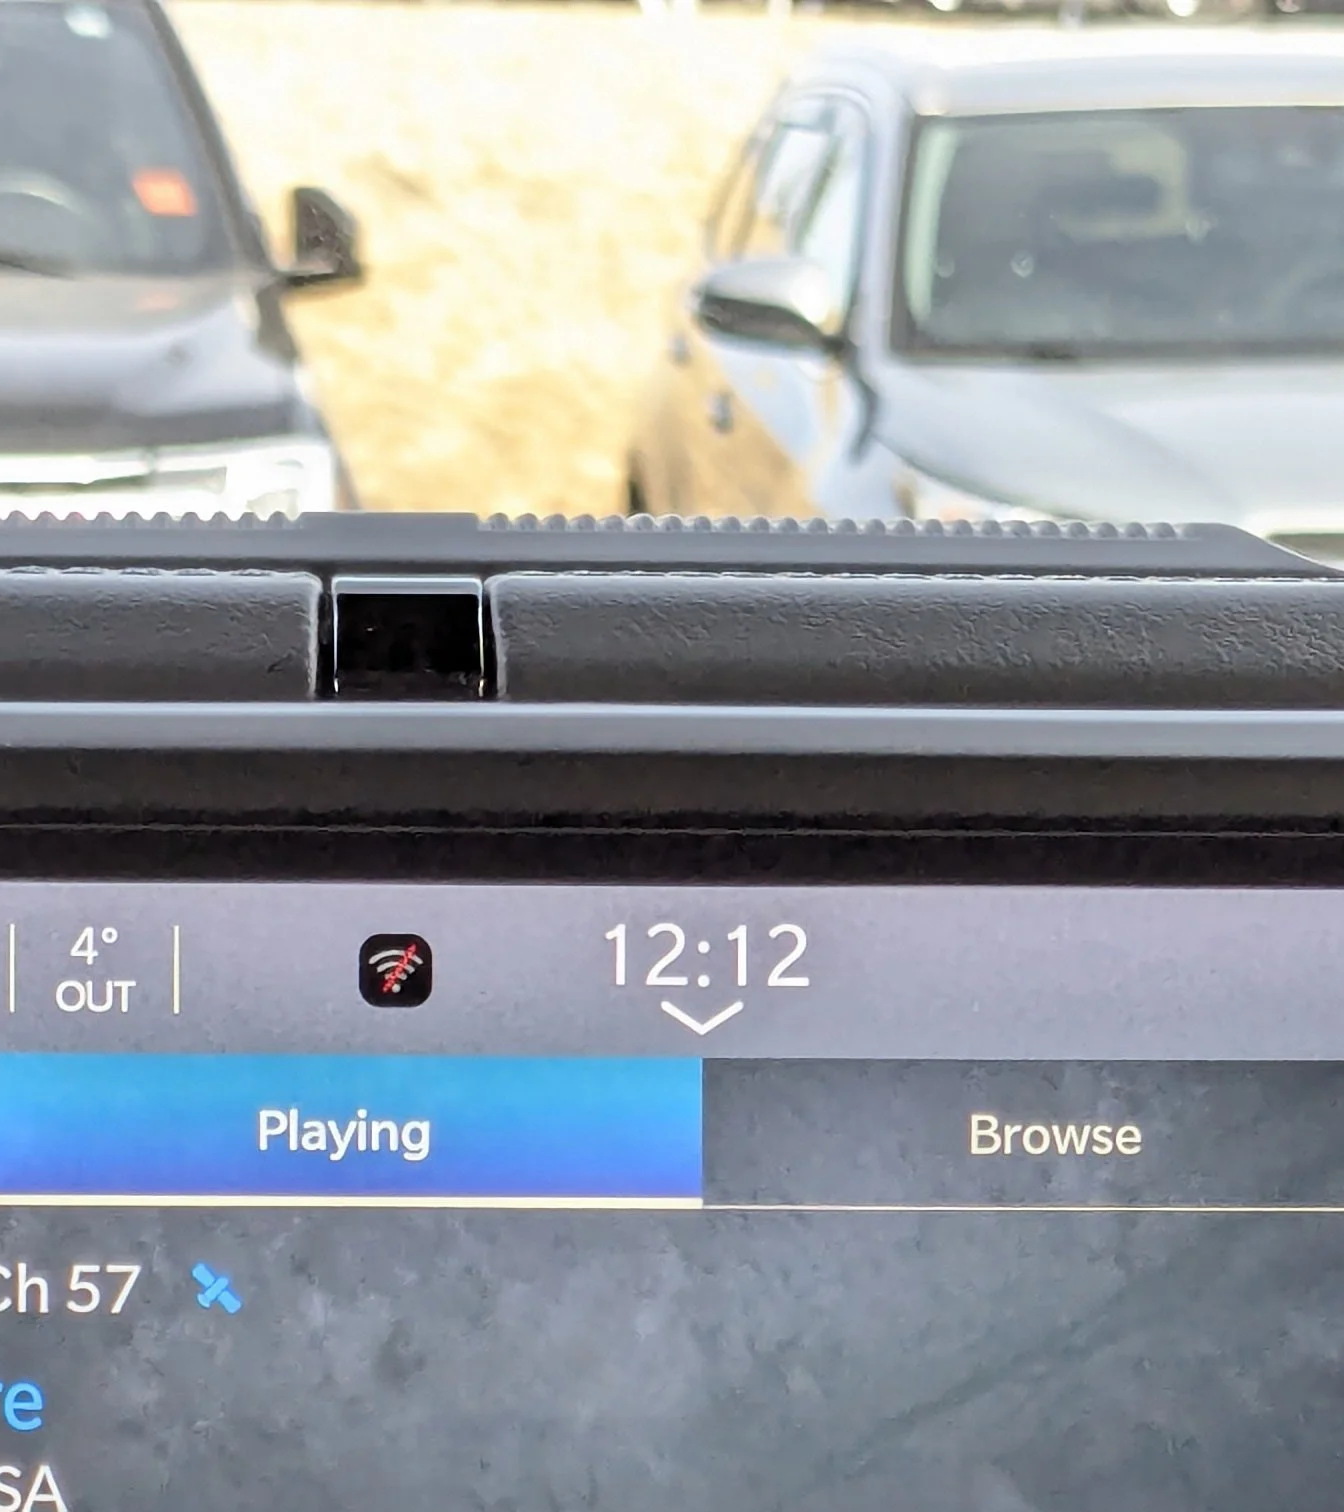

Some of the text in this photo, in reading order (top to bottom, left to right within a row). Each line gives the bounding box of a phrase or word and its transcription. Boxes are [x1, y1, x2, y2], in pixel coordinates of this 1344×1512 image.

[69, 927, 118, 963] 4°
[603, 923, 811, 989] 12:12
[55, 981, 136, 1013] OUT
[258, 1108, 431, 1161] Playing
[968, 1113, 1143, 1155] Browse
[65, 1264, 142, 1314] 57
